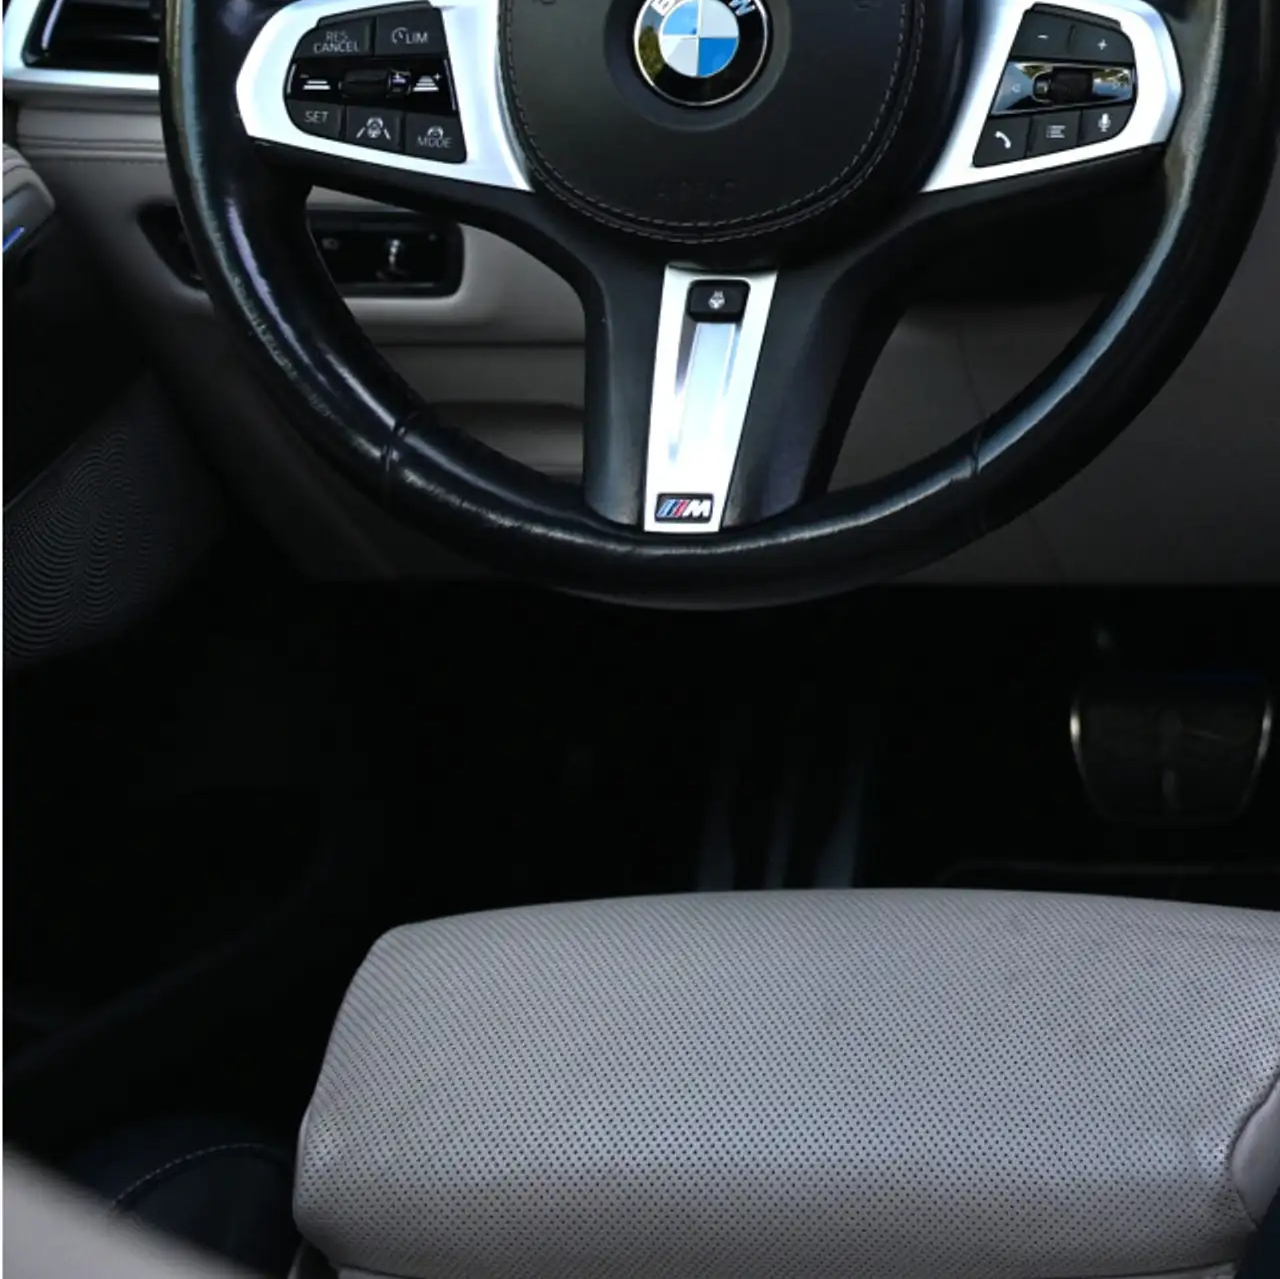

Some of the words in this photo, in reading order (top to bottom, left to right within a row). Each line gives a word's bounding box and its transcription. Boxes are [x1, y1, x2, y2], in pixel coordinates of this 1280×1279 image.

[326, 30, 348, 42] RES
[406, 31, 428, 45] LIM
[313, 40, 360, 53] CANCEL
[304, 110, 329, 123] SET
[417, 136, 452, 148] MODE
